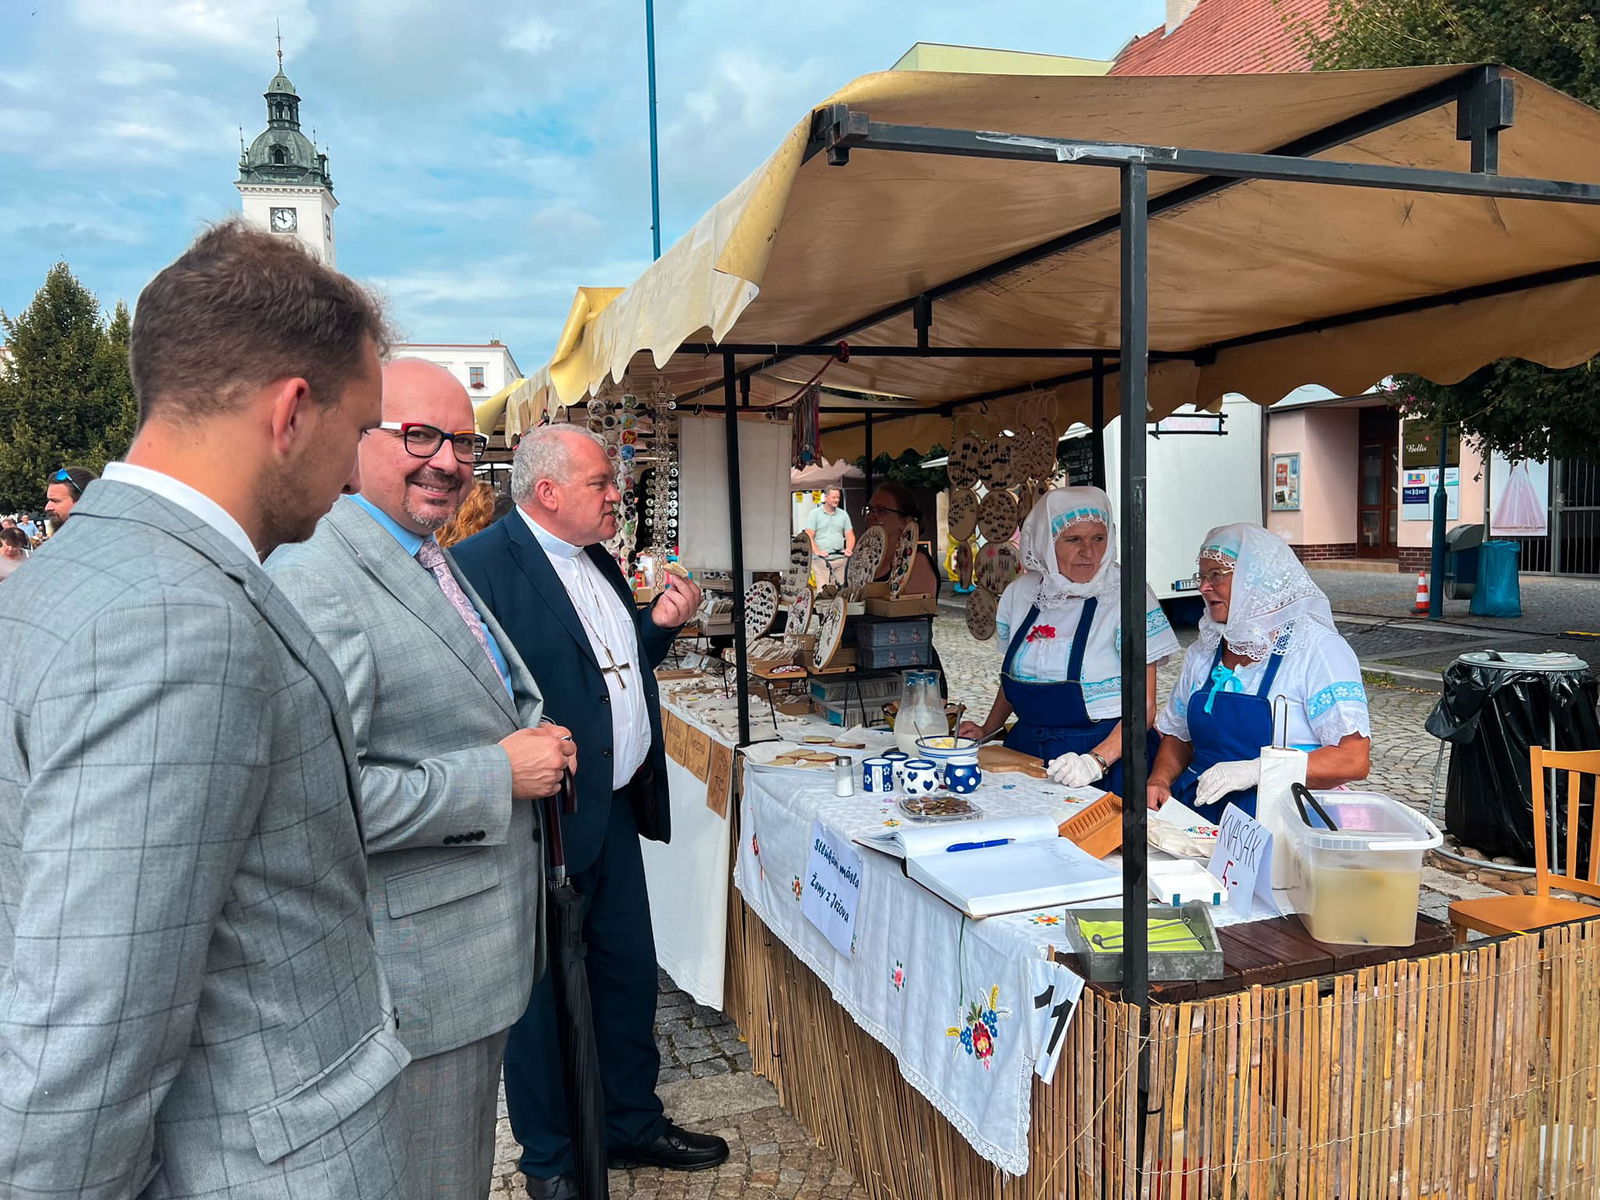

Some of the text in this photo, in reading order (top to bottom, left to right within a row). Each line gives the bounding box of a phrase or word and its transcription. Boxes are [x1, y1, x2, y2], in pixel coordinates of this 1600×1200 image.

[1220, 810, 1262, 873] KVAŠÁK
[811, 872, 826, 897] Ženy
[825, 892, 831, 902] z
[840, 866, 859, 888] másla
